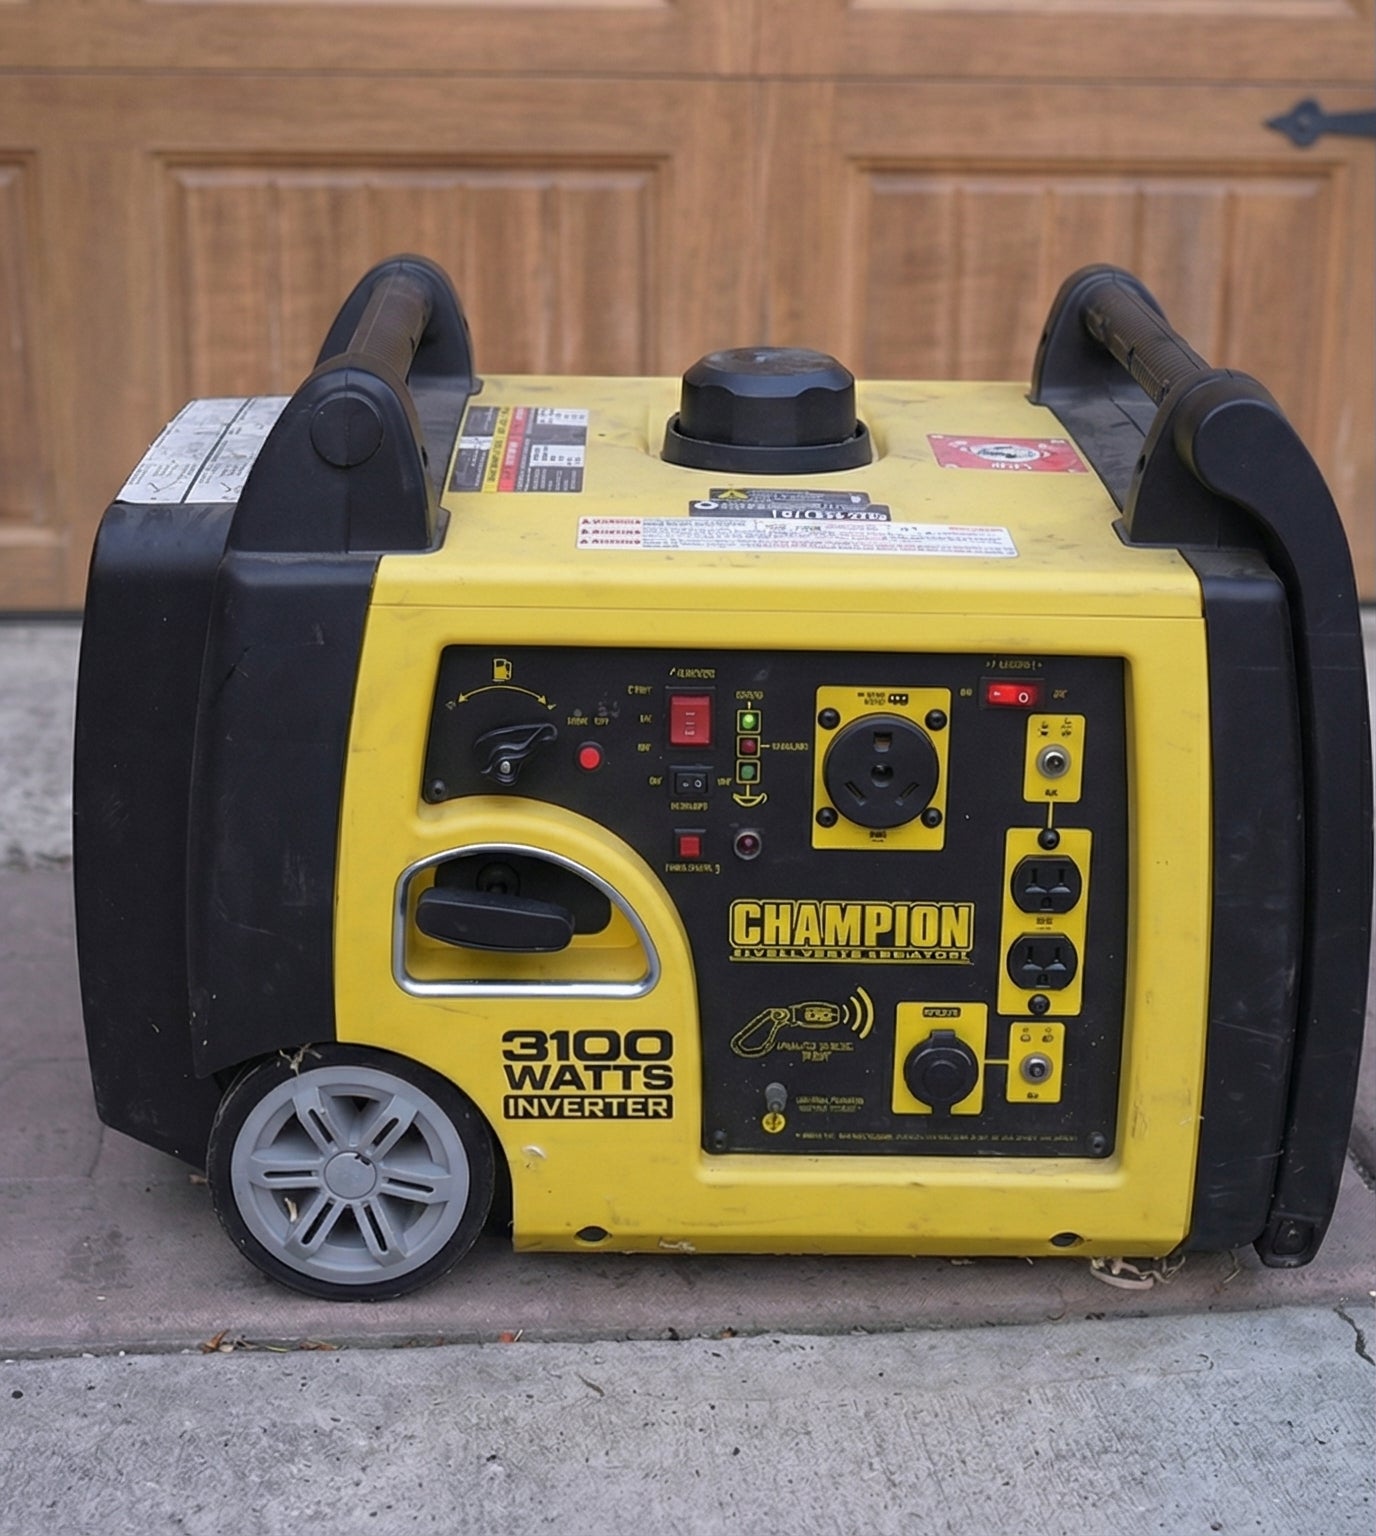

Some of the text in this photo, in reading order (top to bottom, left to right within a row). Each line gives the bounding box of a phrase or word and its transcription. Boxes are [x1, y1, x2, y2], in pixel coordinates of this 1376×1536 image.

[731, 901, 972, 949] CHAMPION
[502, 1029, 674, 1062] 3100
[502, 1064, 674, 1091] WATTS
[507, 1097, 669, 1117] INVERTER
